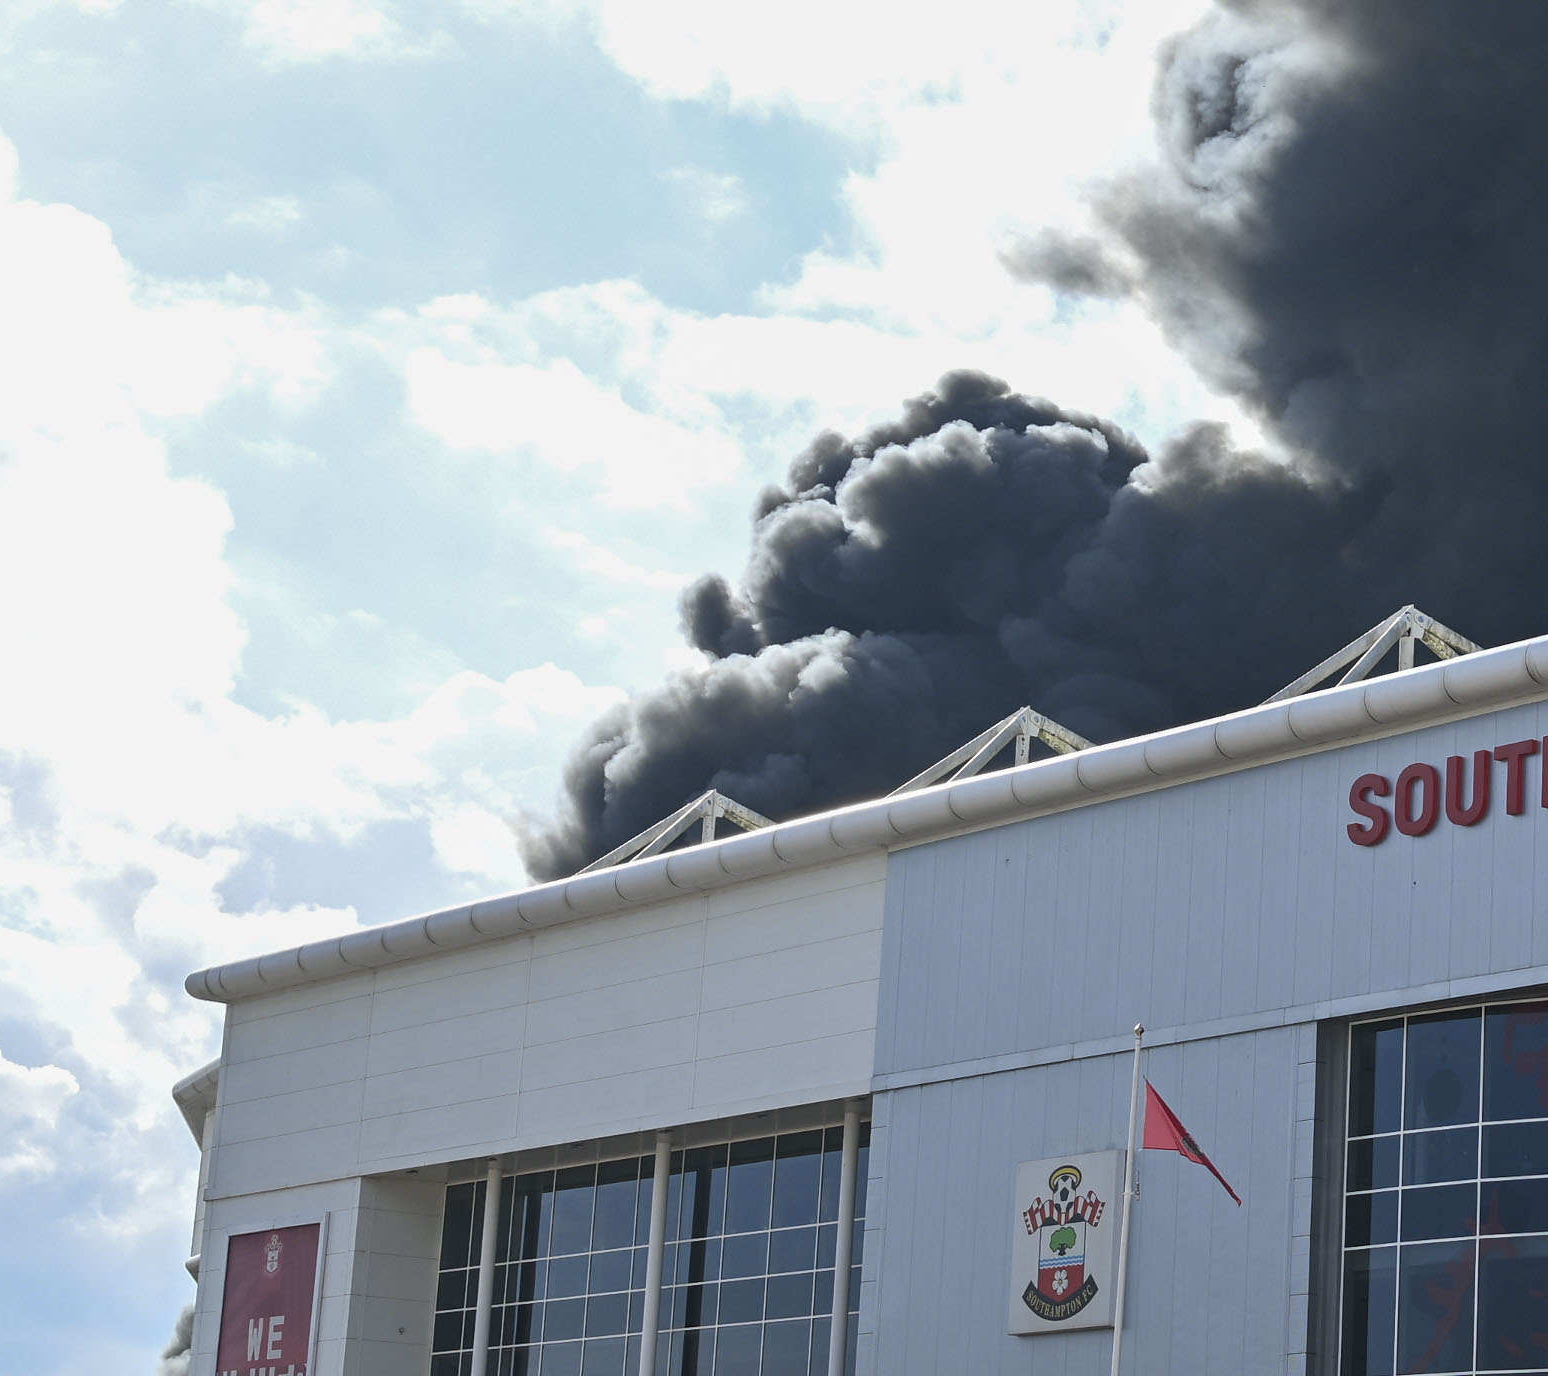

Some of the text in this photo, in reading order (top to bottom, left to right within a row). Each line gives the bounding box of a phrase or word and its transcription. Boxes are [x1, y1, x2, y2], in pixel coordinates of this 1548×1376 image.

[1026, 1284, 1093, 1318] SOUTHAMPTON FC
[247, 1315, 286, 1362] WE
